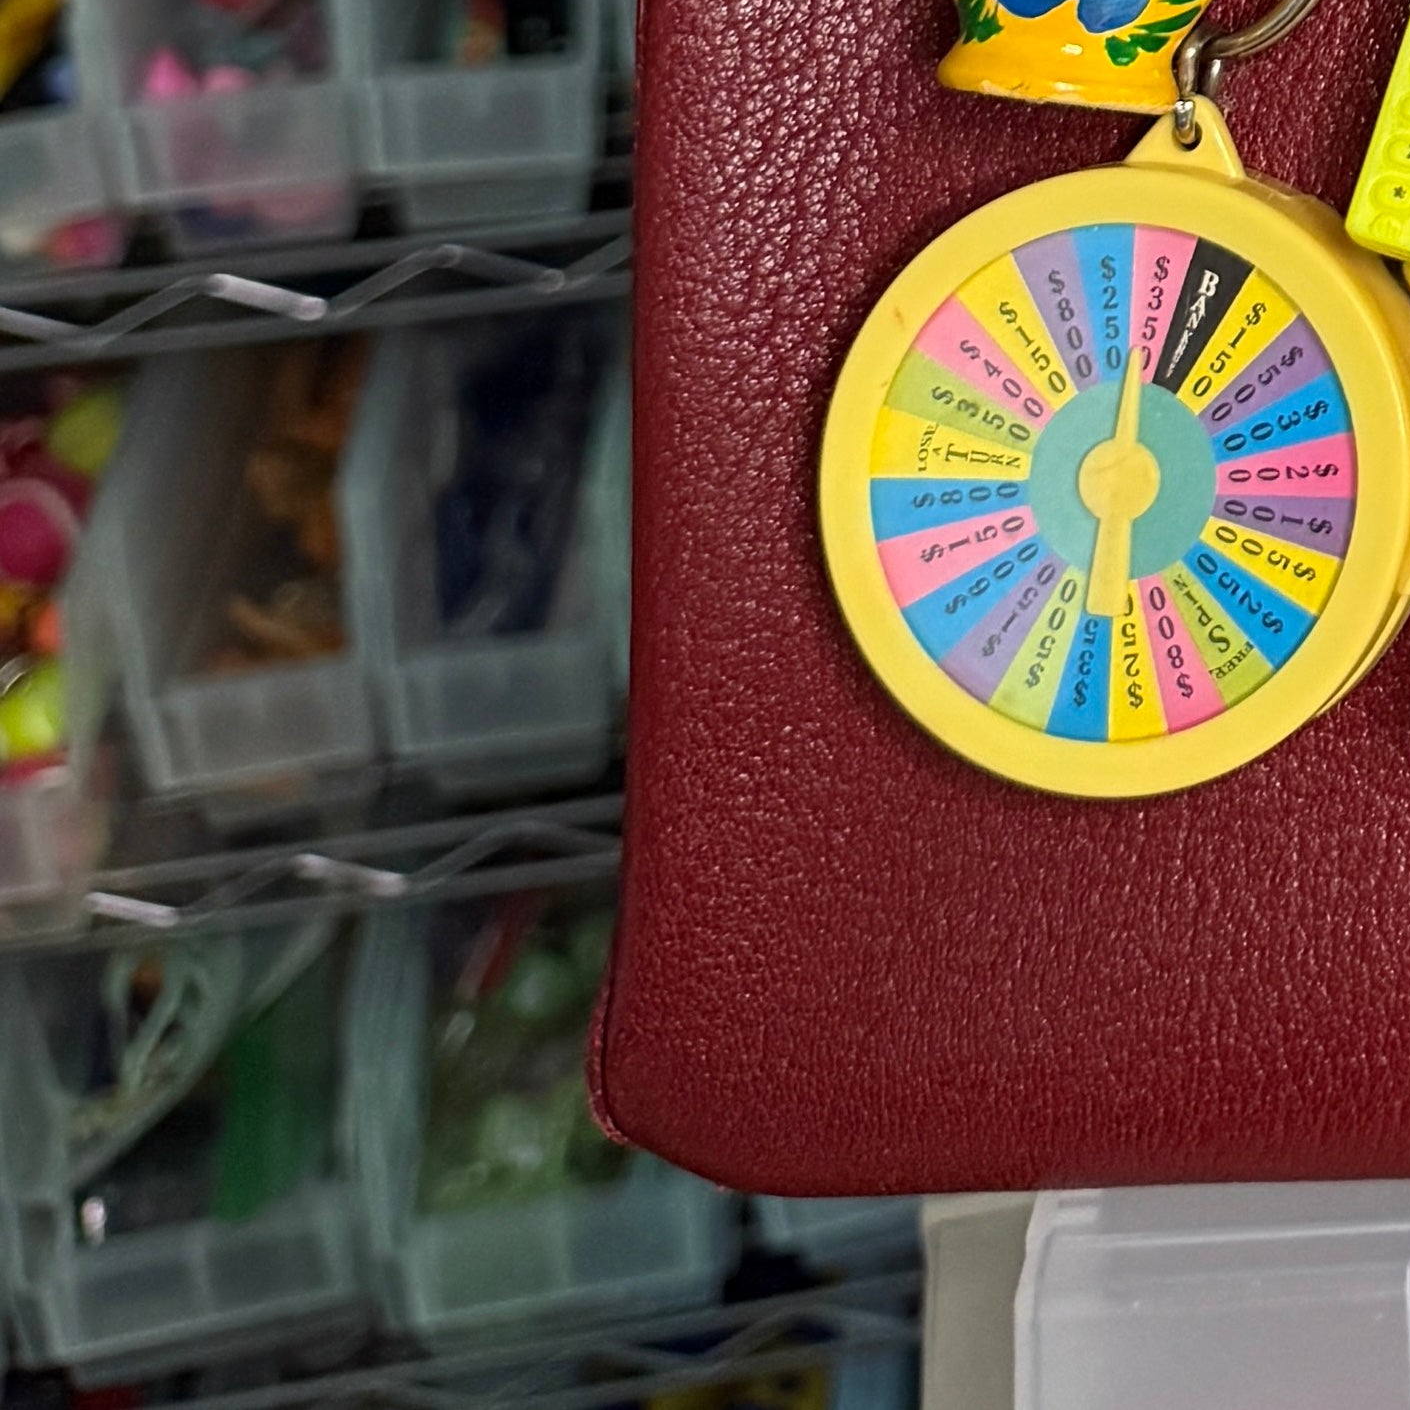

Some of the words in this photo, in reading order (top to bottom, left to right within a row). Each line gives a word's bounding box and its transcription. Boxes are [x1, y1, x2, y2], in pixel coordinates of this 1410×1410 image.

[998, 301, 1067, 394] $150
[1048, 269, 1092, 378] $800
[1100, 254, 1121, 369] $250
[1192, 301, 1267, 397] $150
[931, 385, 1031, 442] $350
[959, 339, 1044, 419] $400
[1211, 345, 1304, 422] $500
[917, 422, 940, 472] LOSE
[944, 443, 1021, 469] TURN
[1222, 399, 1330, 452] $300
[912, 481, 1020, 508] $800
[1228, 463, 1339, 483] $200
[920, 515, 1025, 563] $150
[1215, 525, 1317, 582] $500
[1223, 499, 1333, 535] $100
[944, 542, 1040, 615] $600
[982, 562, 1056, 658] $150
[1173, 573, 1231, 654] SPIN
[1196, 553, 1285, 634] $250
[1025, 578, 1078, 689] $500
[1149, 586, 1194, 699] $800
[1208, 641, 1255, 679] FREE
